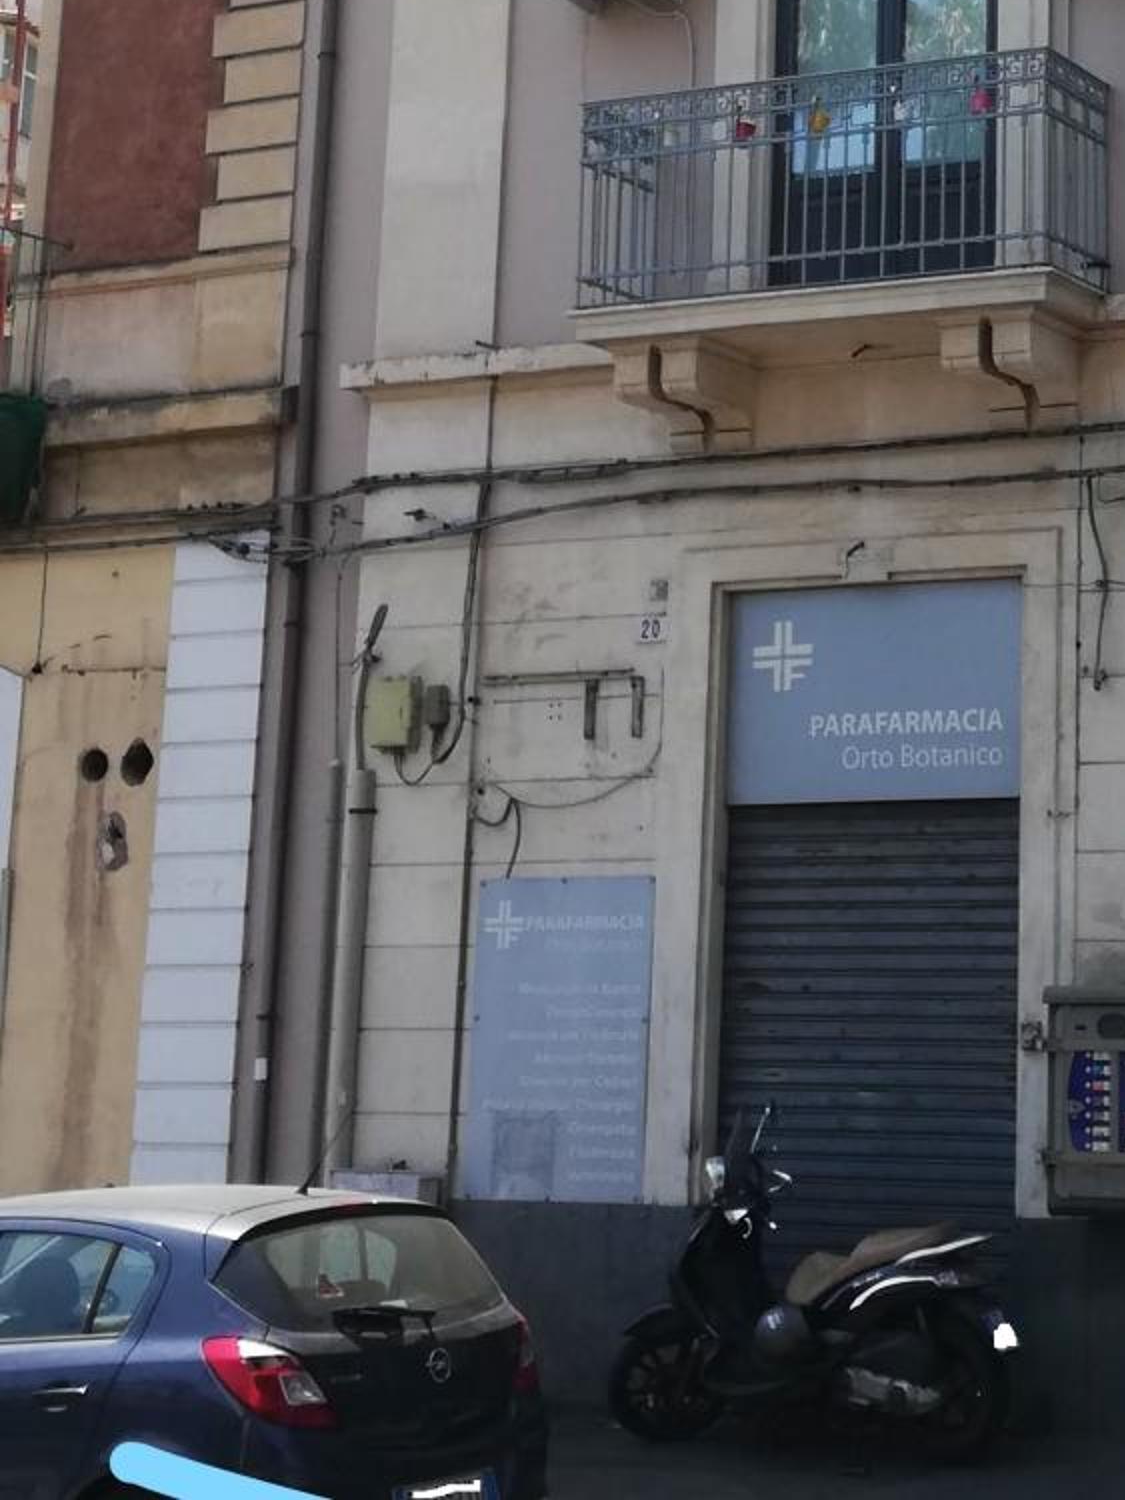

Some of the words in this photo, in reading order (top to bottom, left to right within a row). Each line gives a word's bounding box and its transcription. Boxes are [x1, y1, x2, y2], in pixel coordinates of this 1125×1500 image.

[640, 618, 661, 640] 20
[810, 708, 1003, 739] PARAFARMACIA
[842, 746, 894, 769] Orto
[901, 744, 1002, 768] Botanico
